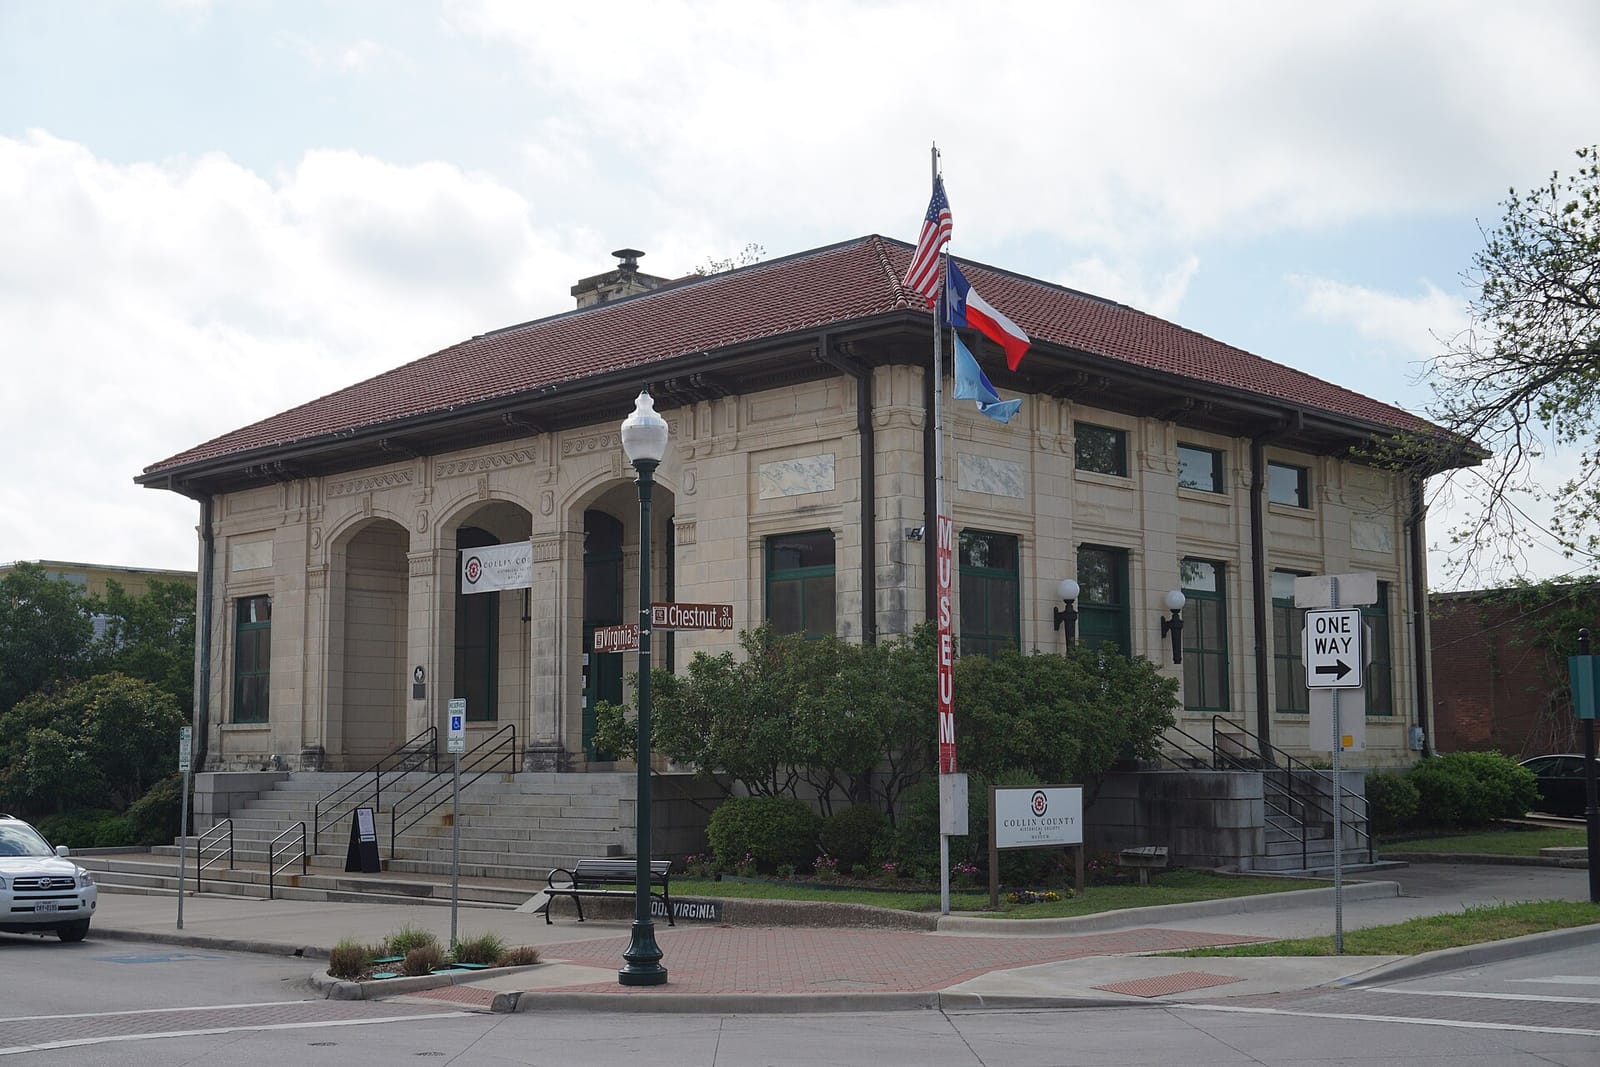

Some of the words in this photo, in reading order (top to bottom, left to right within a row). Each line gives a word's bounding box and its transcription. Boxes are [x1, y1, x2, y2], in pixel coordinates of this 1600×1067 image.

[669, 605, 717, 627] Chestnut
[722, 606, 729, 617] St
[719, 617, 732, 628] 100
[938, 517, 955, 744] MUSEUM
[1316, 616, 1351, 634] ONE
[603, 625, 632, 650] Virginia
[1315, 637, 1352, 654] WAY
[1003, 818, 1037, 828] COLLIN
[1041, 817, 1075, 826] COUNTY
[673, 902, 716, 919] VIRGINIA
